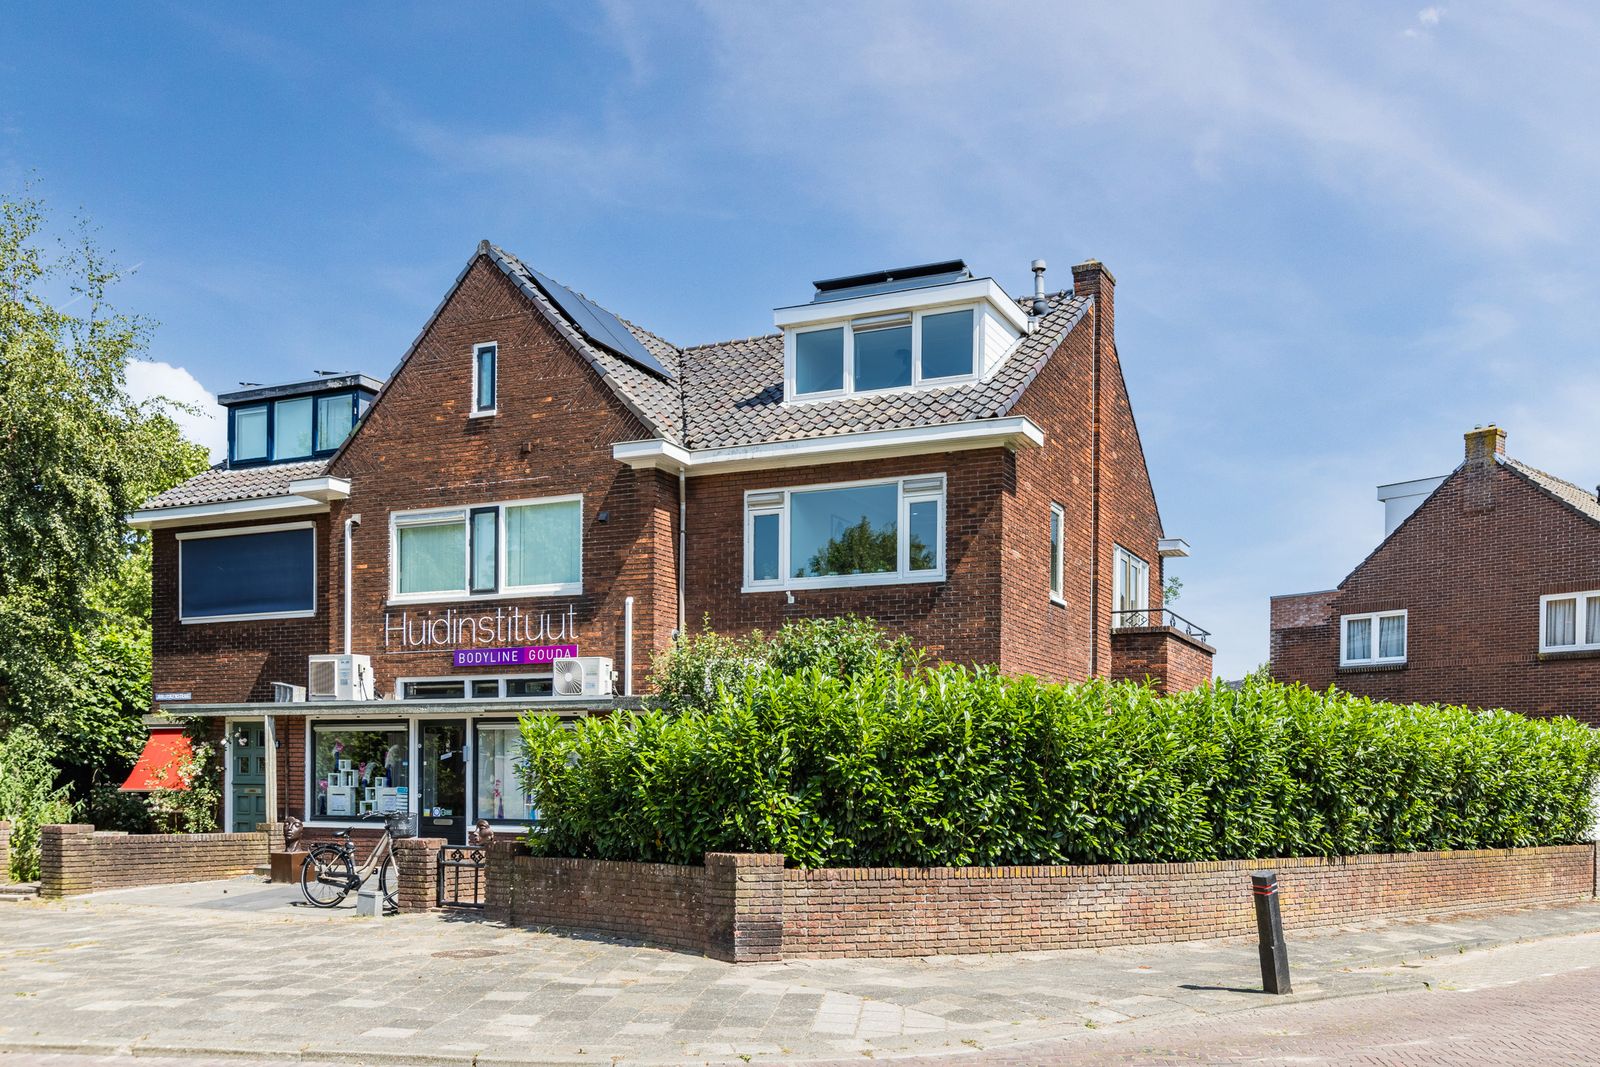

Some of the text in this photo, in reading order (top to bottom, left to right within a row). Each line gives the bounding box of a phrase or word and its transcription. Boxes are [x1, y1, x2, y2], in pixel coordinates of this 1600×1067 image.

[385, 603, 579, 646] Huidinstituut
[458, 648, 571, 664] BODYLINE GOUDA
